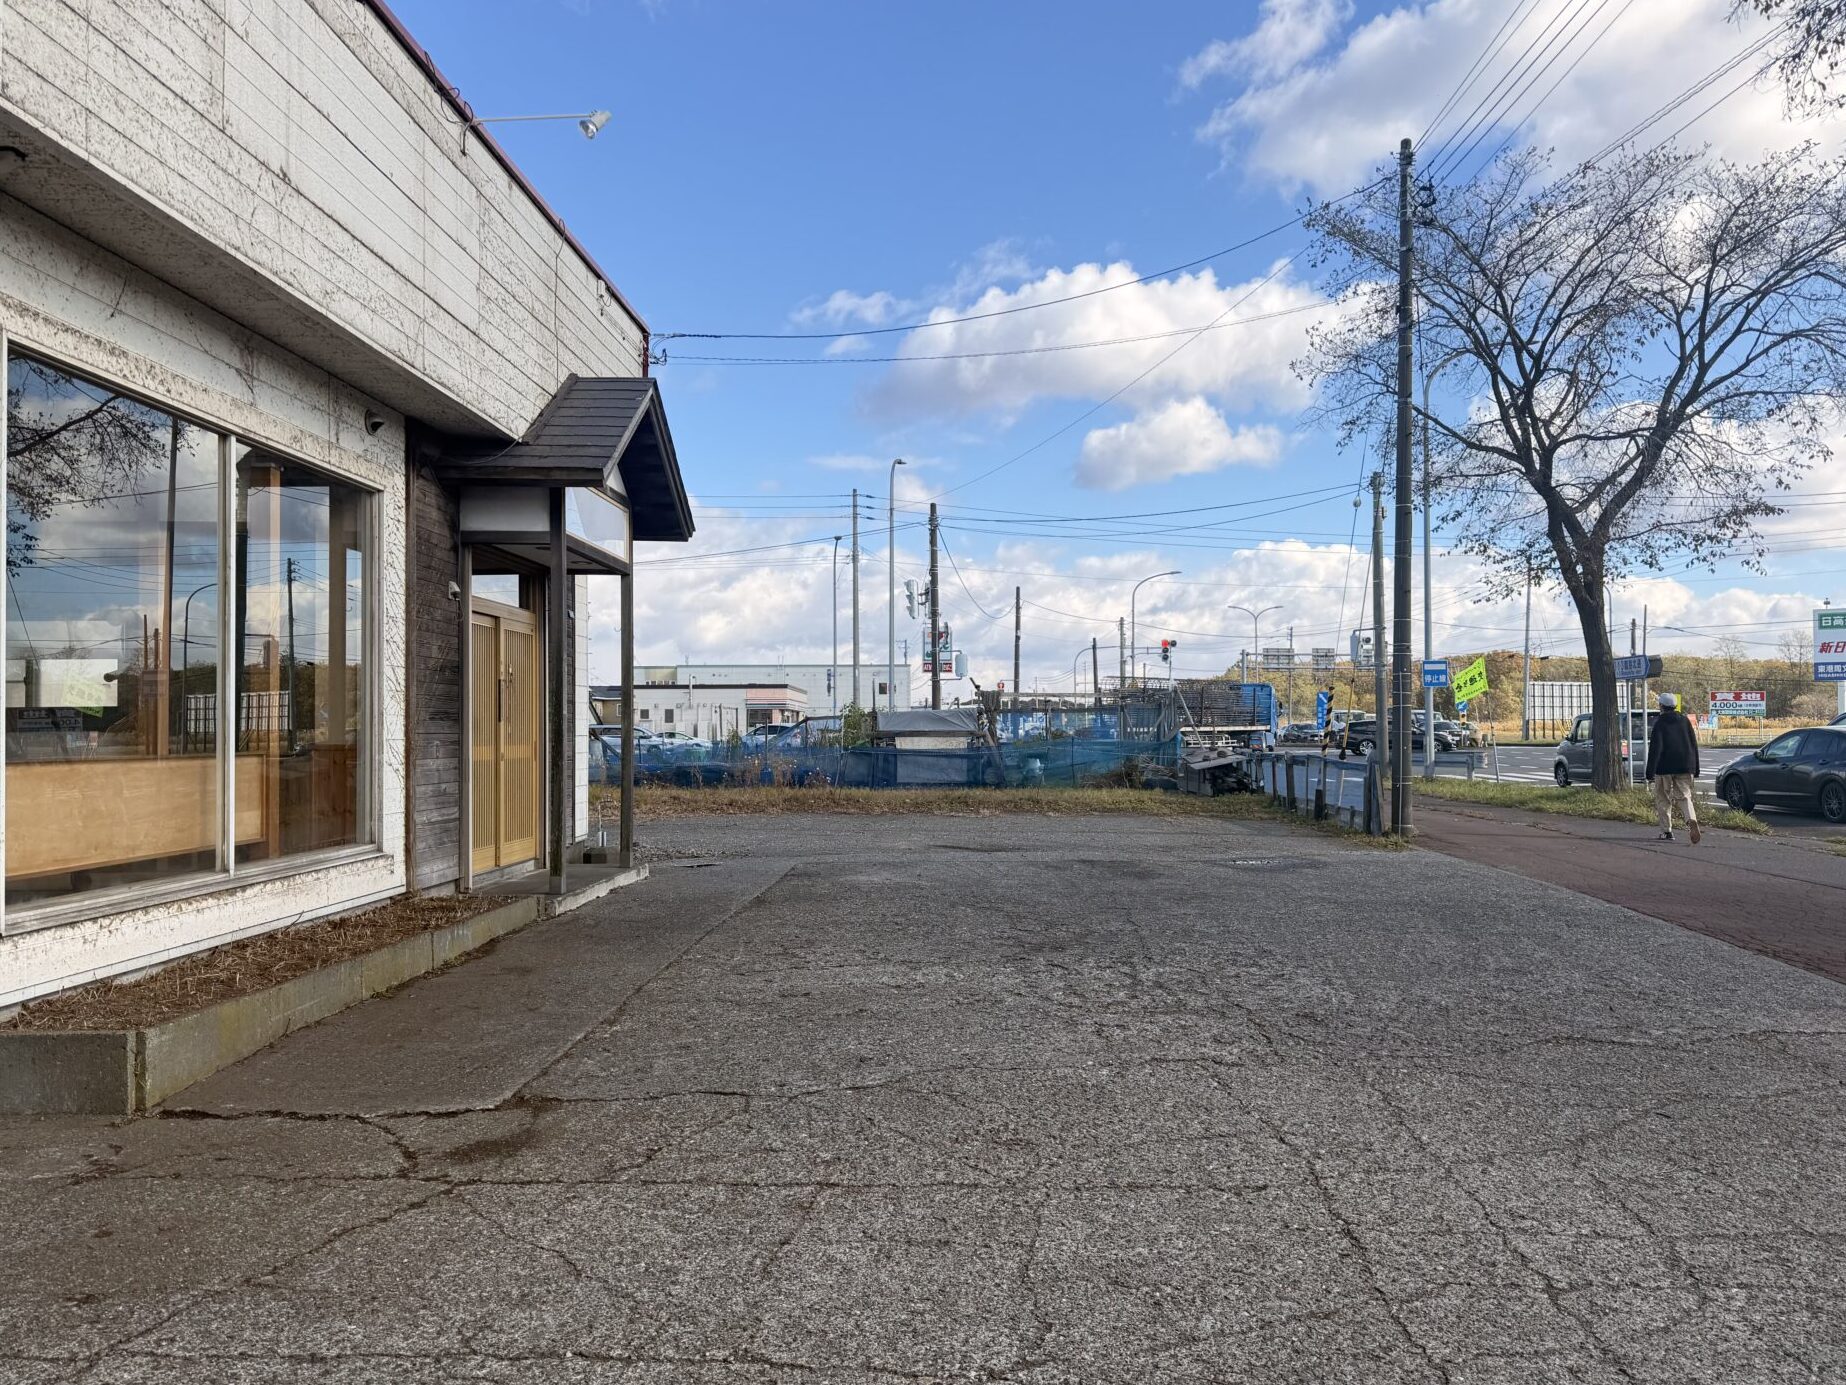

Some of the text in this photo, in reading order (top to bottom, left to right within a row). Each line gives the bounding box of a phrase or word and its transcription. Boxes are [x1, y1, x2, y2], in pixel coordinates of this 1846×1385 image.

[1822, 616, 1846, 626] 日高
[1424, 674, 1447, 683] 停止線
